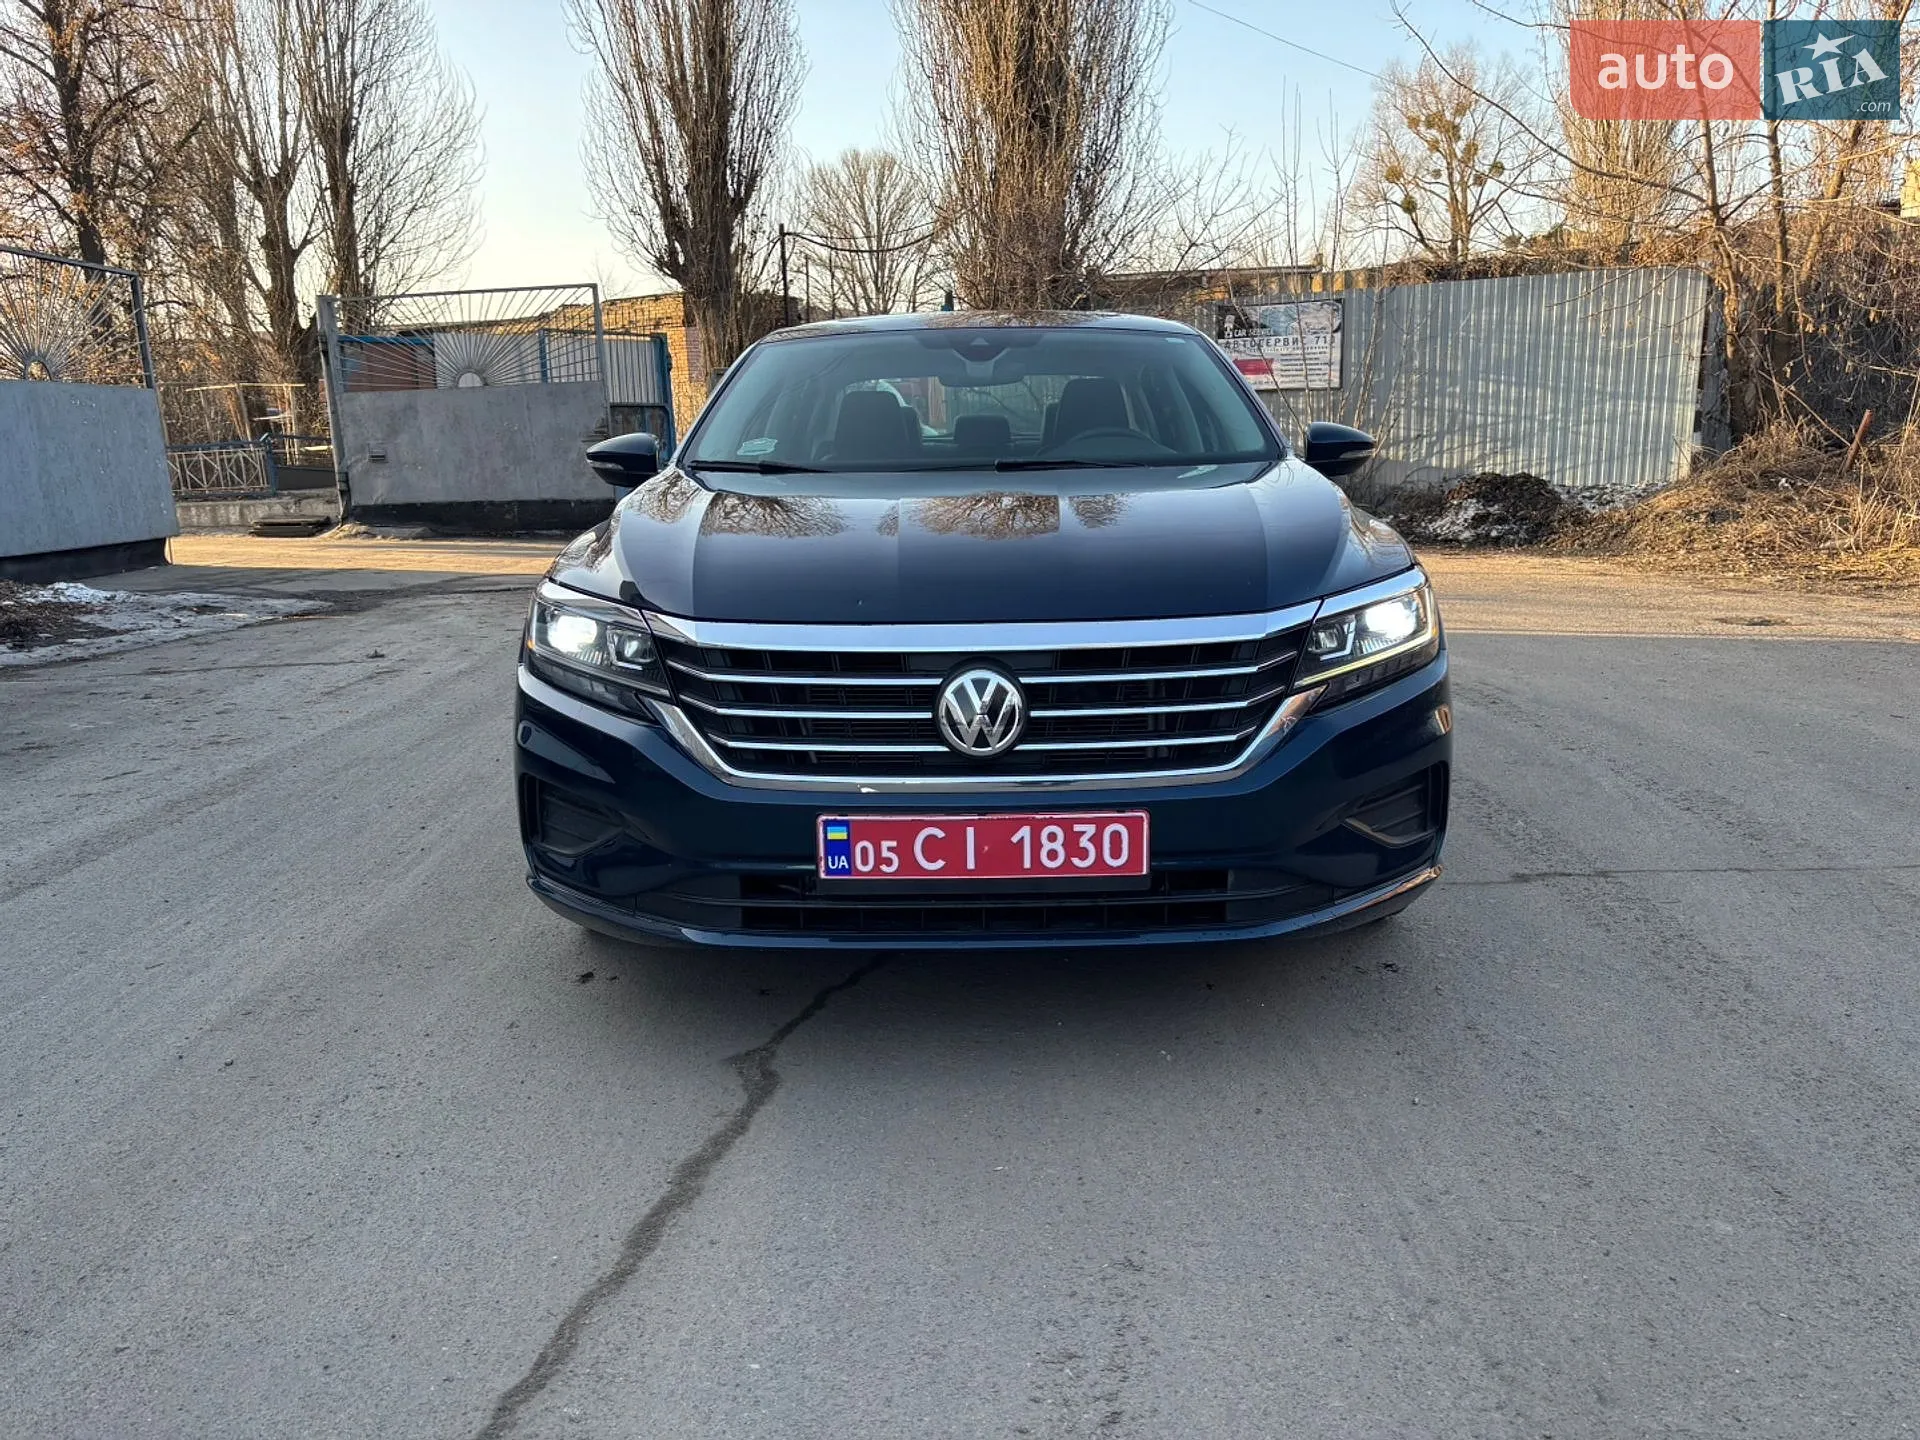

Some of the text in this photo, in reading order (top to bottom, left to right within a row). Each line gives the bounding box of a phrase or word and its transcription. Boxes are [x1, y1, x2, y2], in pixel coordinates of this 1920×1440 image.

[1233, 328, 1247, 337] CAR
[941, 671, 1020, 754] VW
[827, 823, 1130, 873] UA 05 CI 1830
